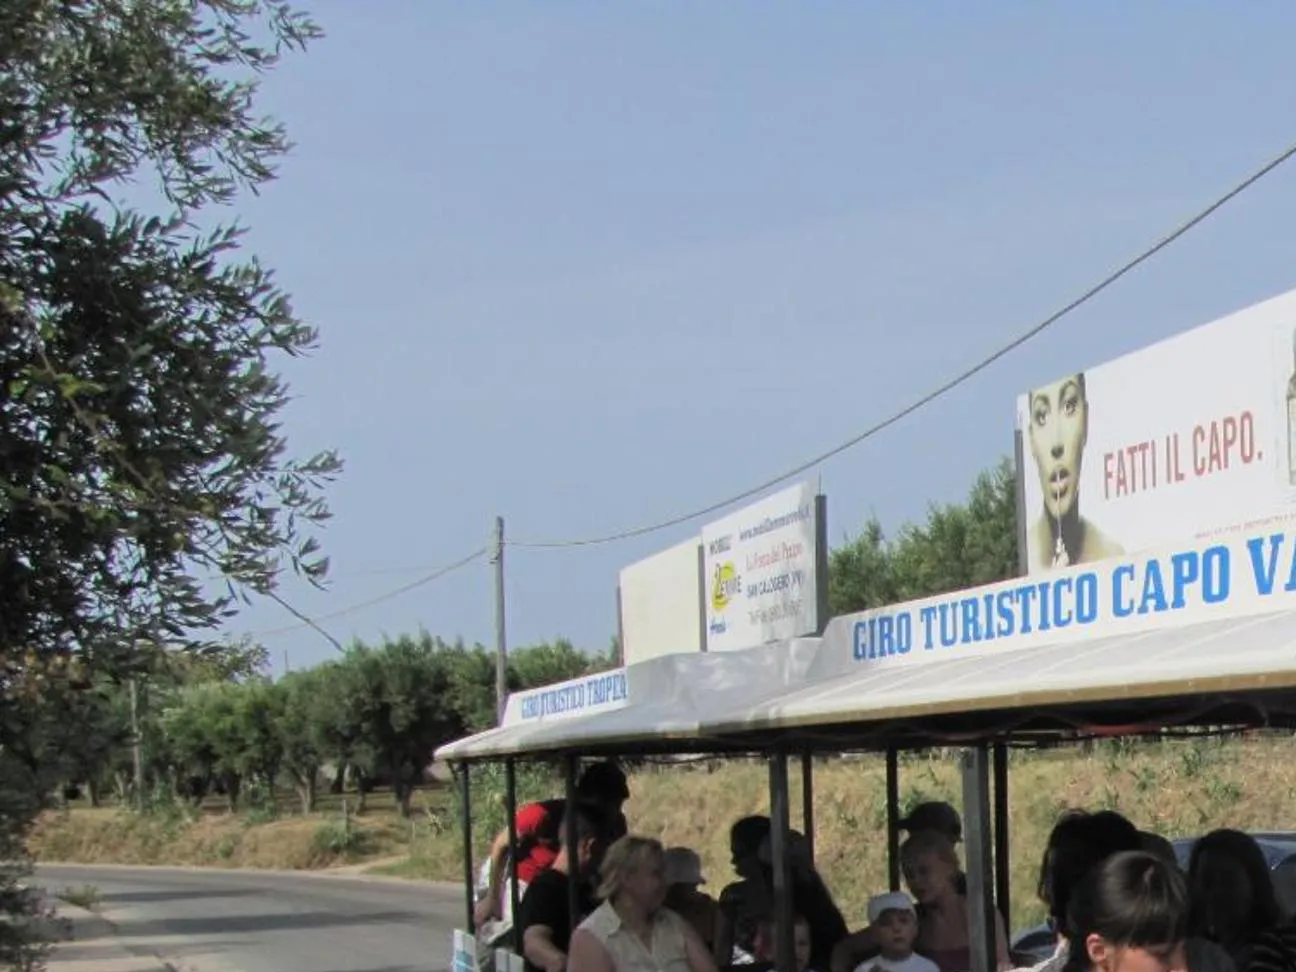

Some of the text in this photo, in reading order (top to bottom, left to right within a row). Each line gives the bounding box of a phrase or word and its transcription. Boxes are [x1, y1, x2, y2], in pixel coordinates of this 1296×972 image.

[1103, 410, 1263, 500] FATTI IL CAPO.
[853, 612, 912, 661] GIRO
[921, 572, 1098, 649] TURISTICO
[1112, 545, 1230, 615] CAPO
[521, 674, 627, 719] GIRO TURISTICO TROPEA
